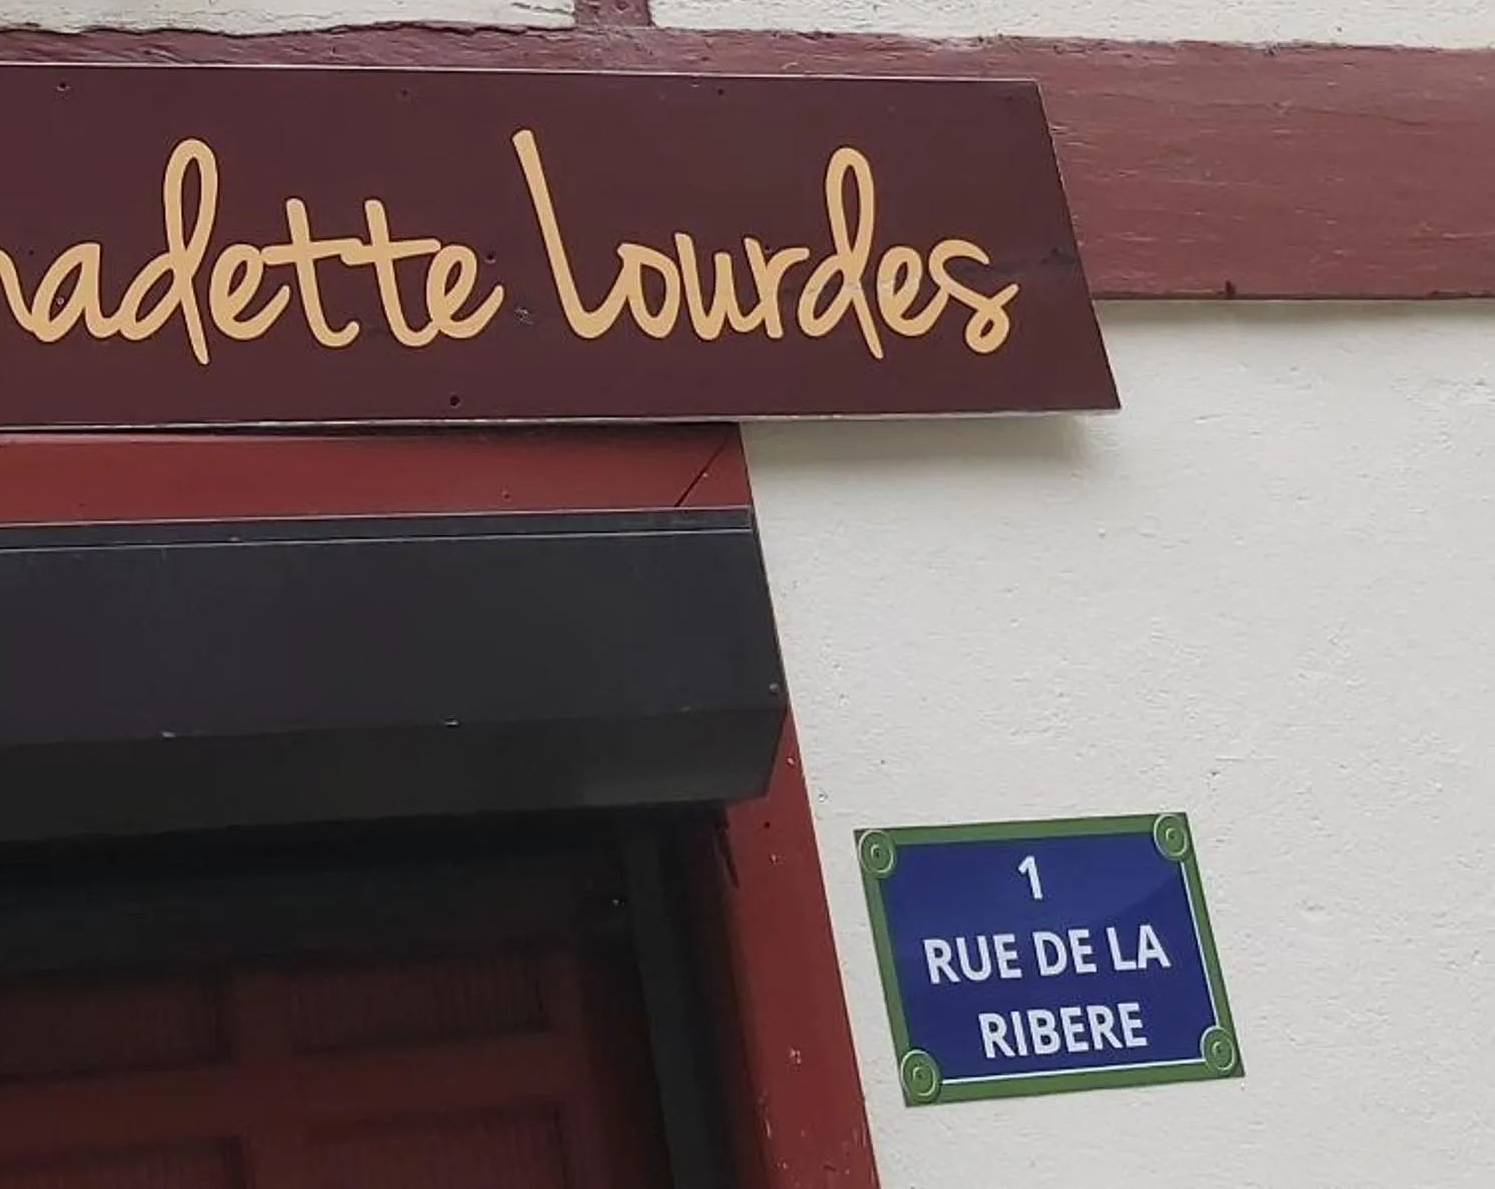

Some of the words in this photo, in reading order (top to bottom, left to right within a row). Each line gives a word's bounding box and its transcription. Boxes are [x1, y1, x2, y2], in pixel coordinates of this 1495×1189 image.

[512, 130, 1019, 360] Lourdes
[1017, 855, 1044, 900] 1
[923, 933, 1023, 984] RUE
[1033, 928, 1097, 977] DE
[1106, 924, 1171, 971] LA
[978, 1002, 1149, 1059] RIBERE
